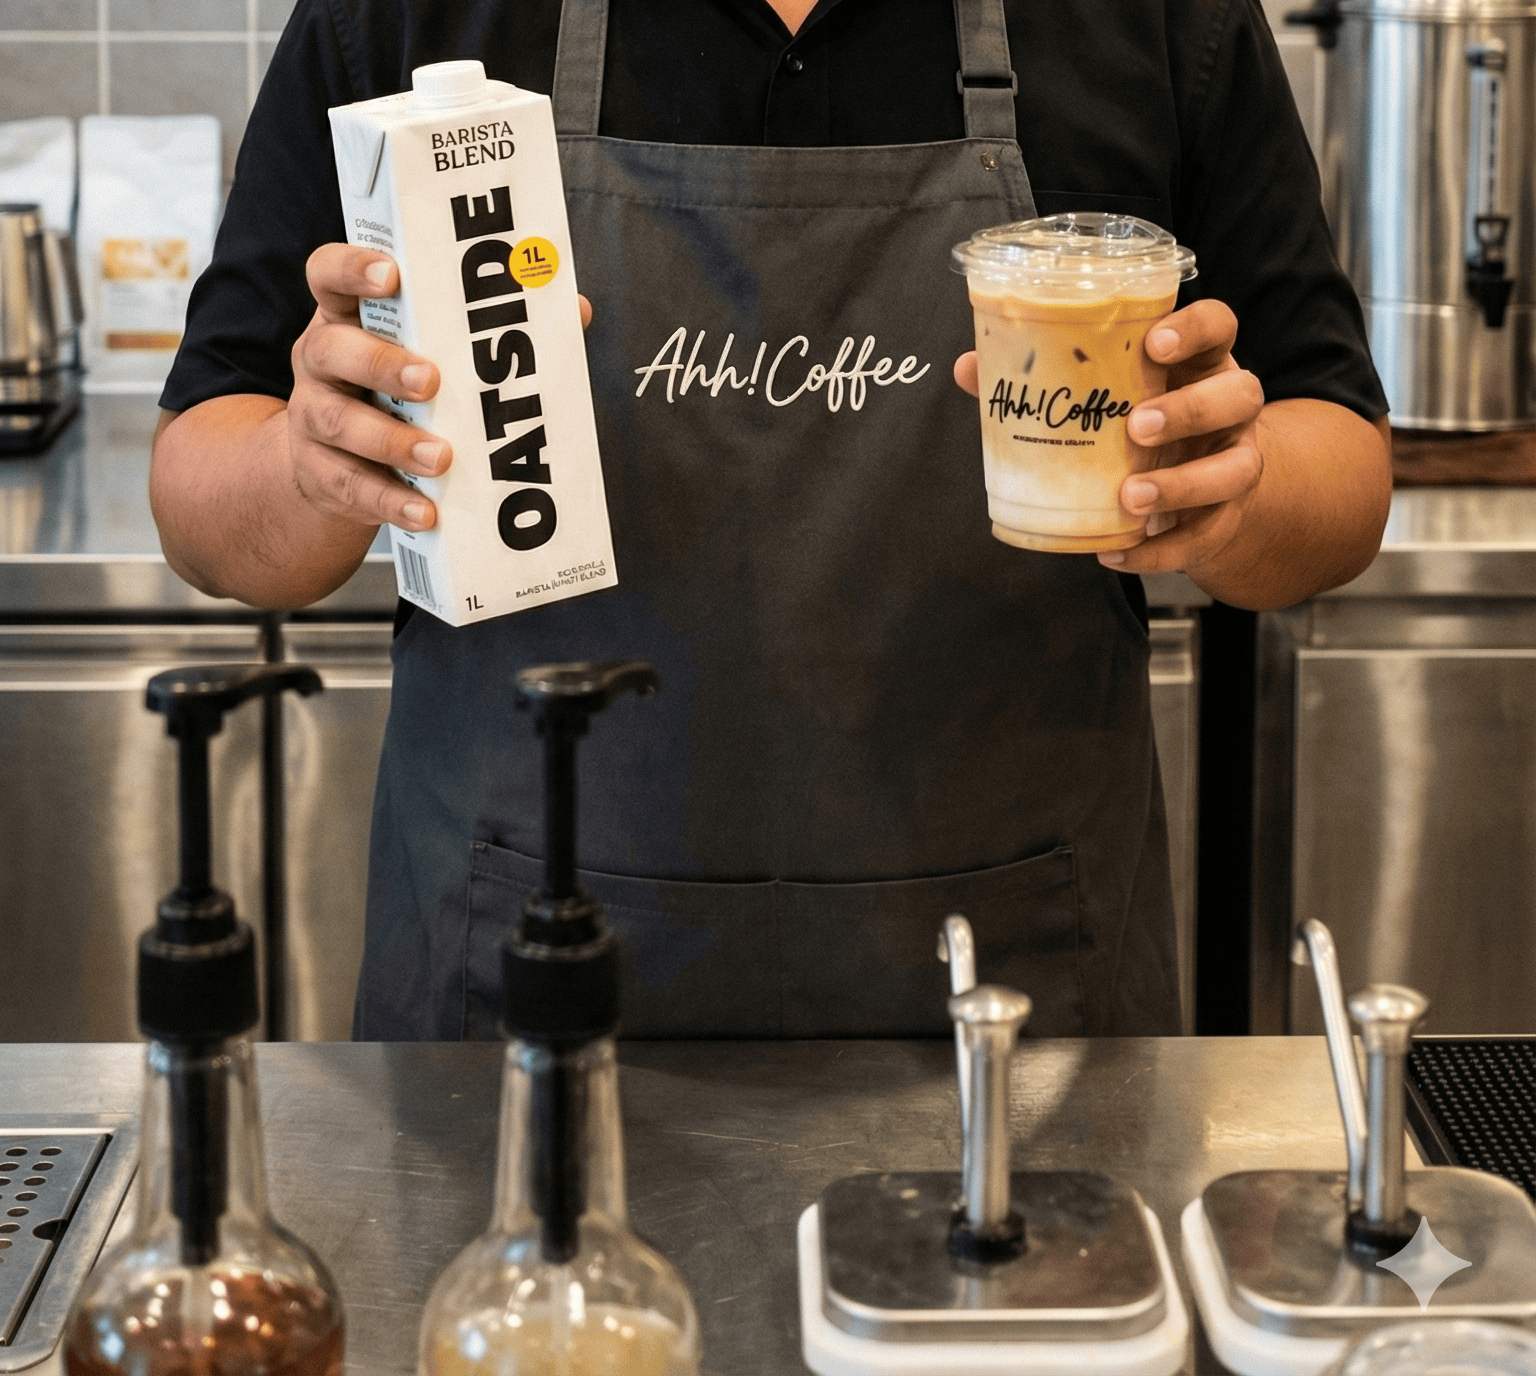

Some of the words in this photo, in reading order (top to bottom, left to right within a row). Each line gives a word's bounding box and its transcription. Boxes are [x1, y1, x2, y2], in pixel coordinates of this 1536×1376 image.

[431, 120, 514, 150] BARISTA
[434, 139, 516, 173] BLEND
[522, 246, 546, 265] 1L
[449, 185, 558, 552] OATSIDE
[465, 594, 484, 612] 1L
